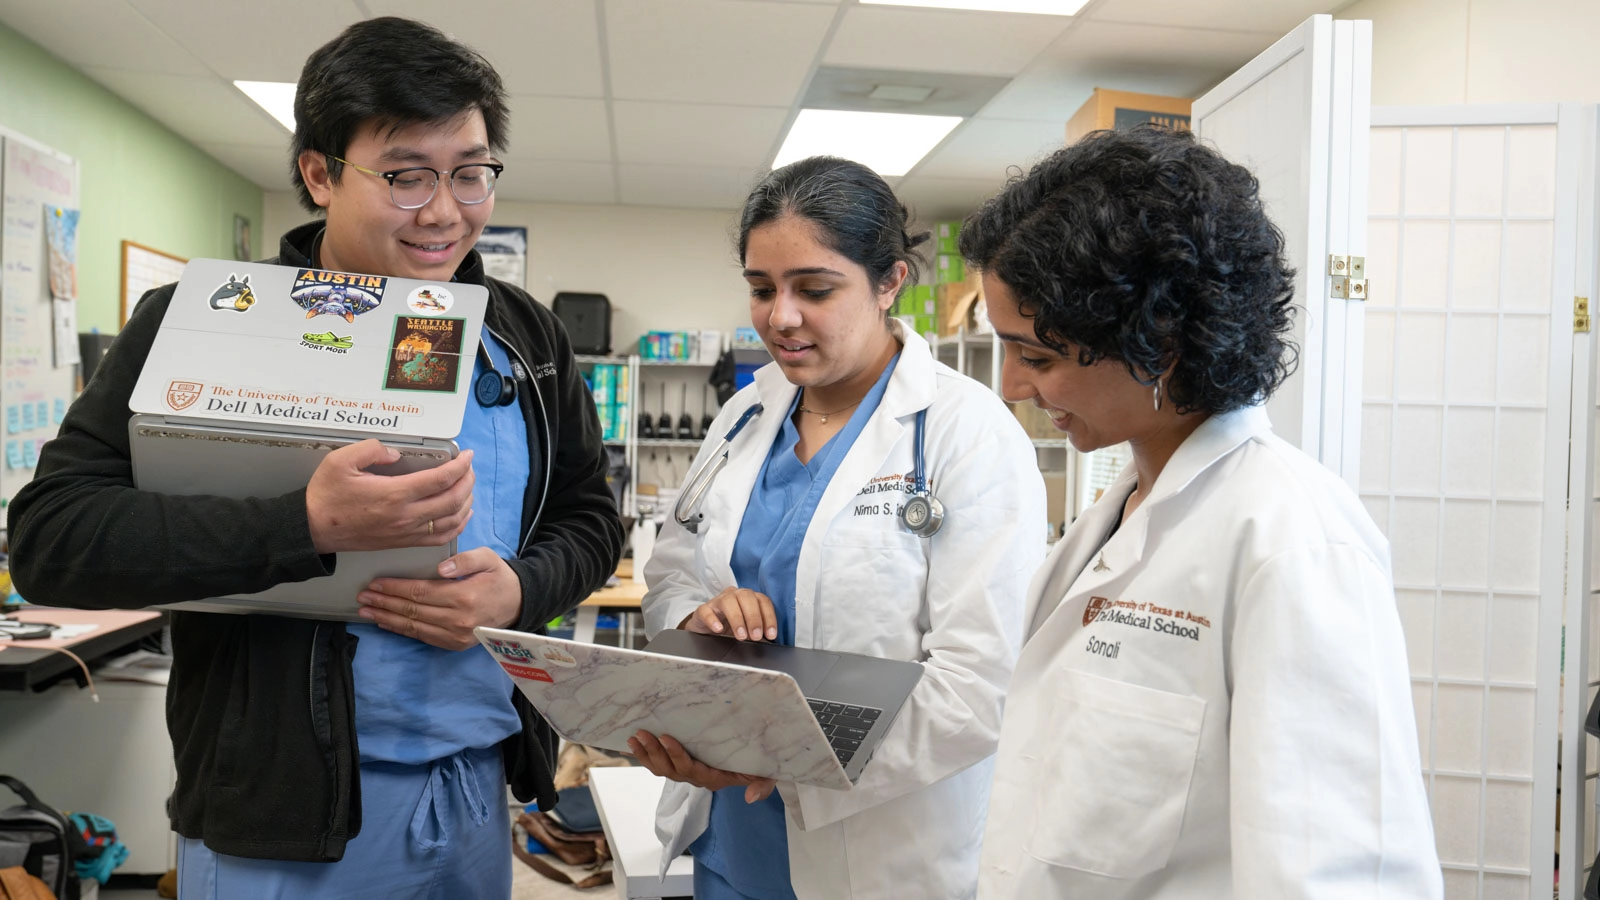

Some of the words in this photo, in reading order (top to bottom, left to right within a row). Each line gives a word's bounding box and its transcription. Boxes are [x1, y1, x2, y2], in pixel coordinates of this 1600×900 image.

[300, 270, 382, 287] AUSTIN
[407, 318, 454, 327] SEATTLE
[407, 324, 453, 332] WASHINGTON
[299, 340, 323, 351] SPORT
[325, 346, 348, 354] MODE
[211, 385, 234, 396] The
[238, 388, 301, 405] University
[305, 395, 320, 404] of
[323, 396, 359, 408] Texas
[361, 401, 374, 410] at
[377, 401, 419, 414] Austin
[205, 398, 248, 414] Dell
[252, 402, 329, 421] Medical
[334, 409, 399, 428] School
[854, 504, 879, 517] Nima
[883, 502, 893, 516] S.
[1138, 601, 1146, 611] of
[1148, 602, 1172, 616] Texas
[1175, 610, 1184, 620] at
[1186, 611, 1211, 628] Austin
[1108, 610, 1151, 630] Medical
[1154, 618, 1200, 641] School
[1086, 635, 1121, 659] Sonali
